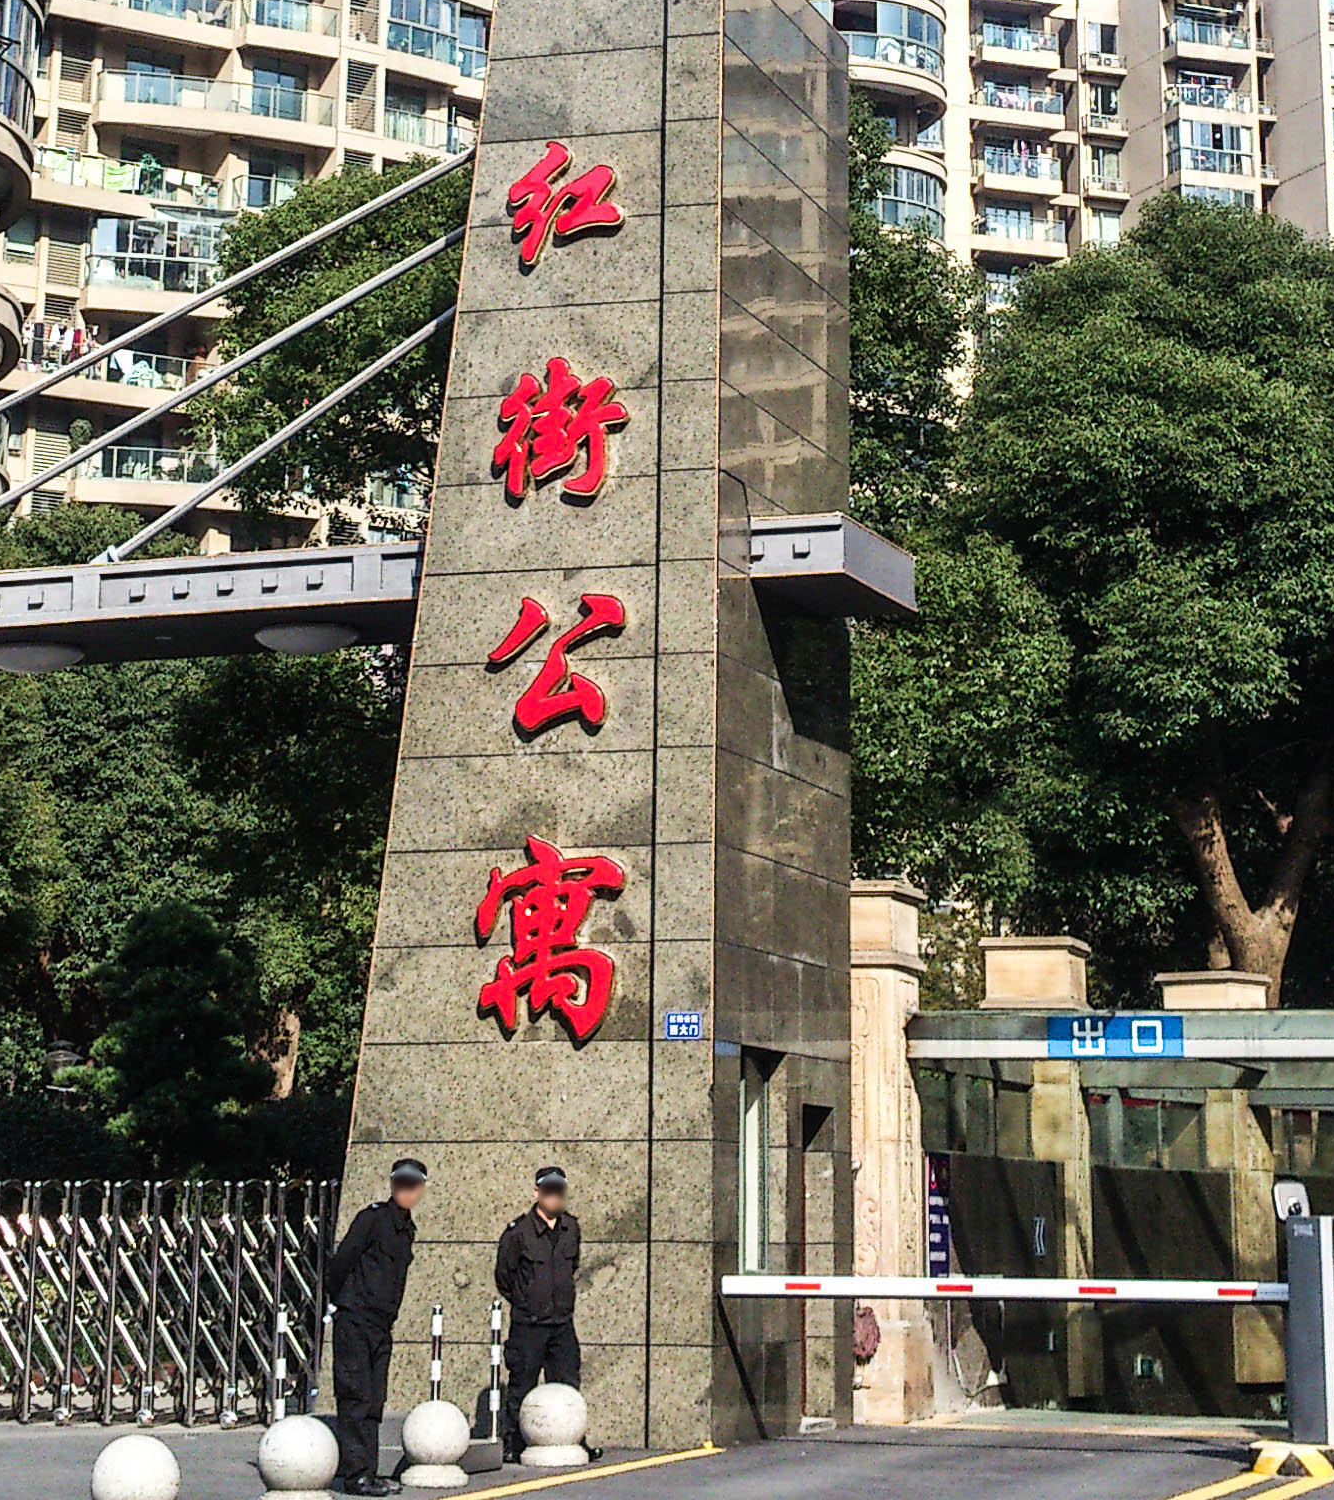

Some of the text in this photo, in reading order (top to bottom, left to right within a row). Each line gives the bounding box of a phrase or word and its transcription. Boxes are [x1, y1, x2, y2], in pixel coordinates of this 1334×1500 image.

[474, 140, 631, 1044] 红街公寓
[1072, 1018, 1164, 1055] 出口
